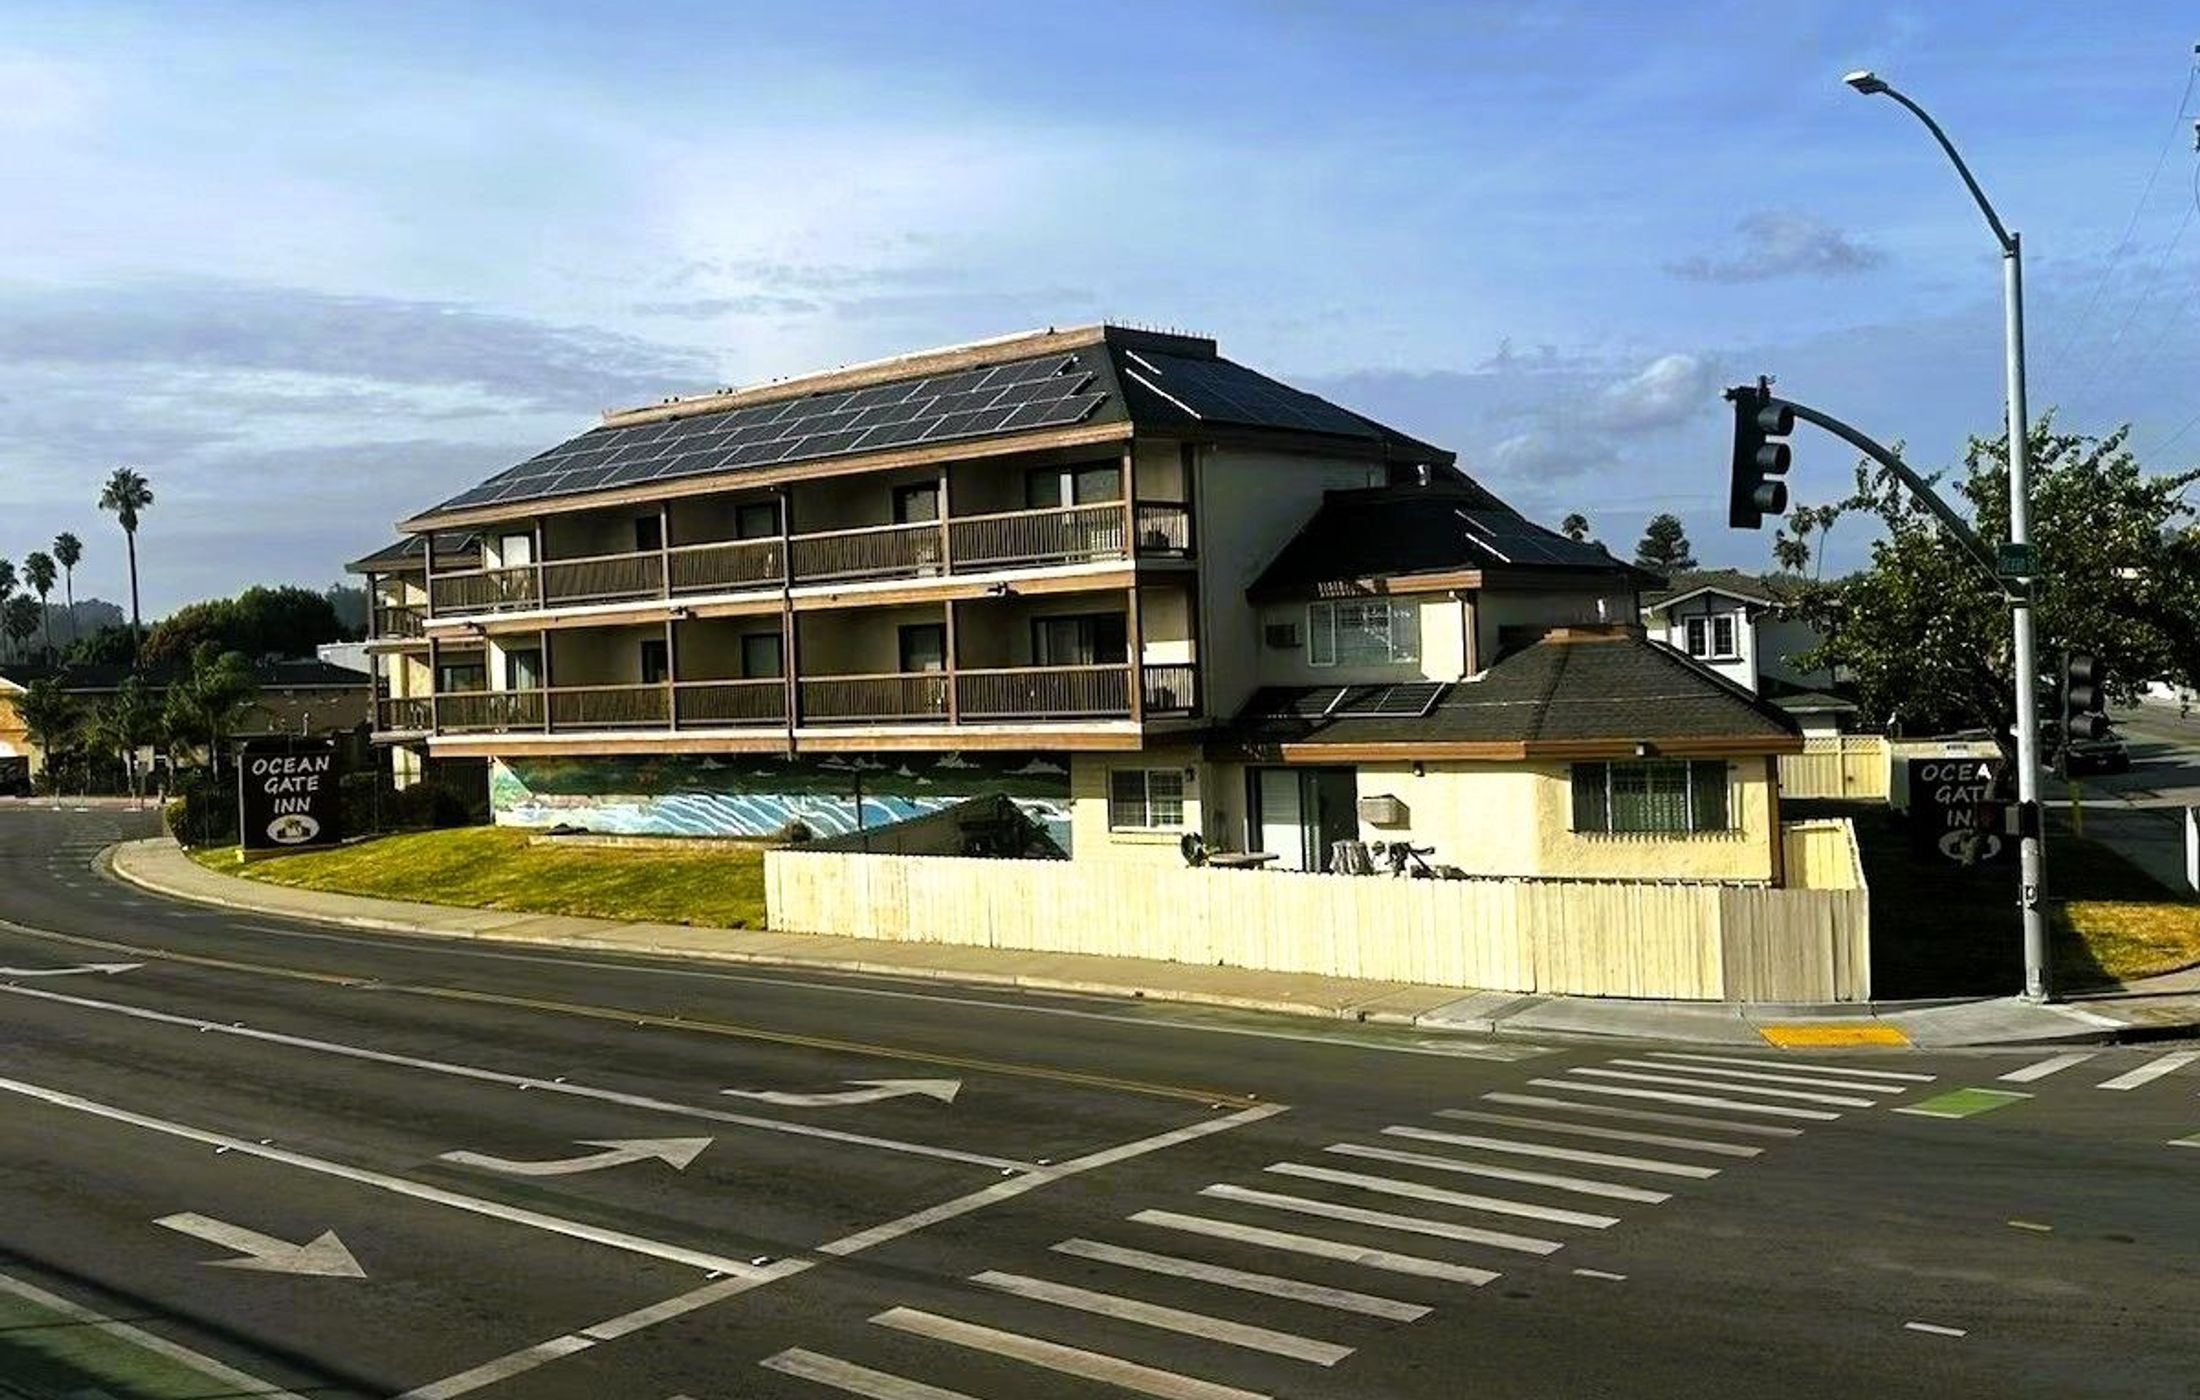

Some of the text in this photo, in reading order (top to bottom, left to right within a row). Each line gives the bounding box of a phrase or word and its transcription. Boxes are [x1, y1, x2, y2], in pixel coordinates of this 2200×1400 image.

[252, 755, 330, 775] OCEAN
[1921, 763, 1996, 782] OCEA
[264, 775, 319, 795] GATE
[1934, 785, 1986, 804] GAT
[274, 796, 311, 814] INN
[1946, 809, 1978, 828] IN
